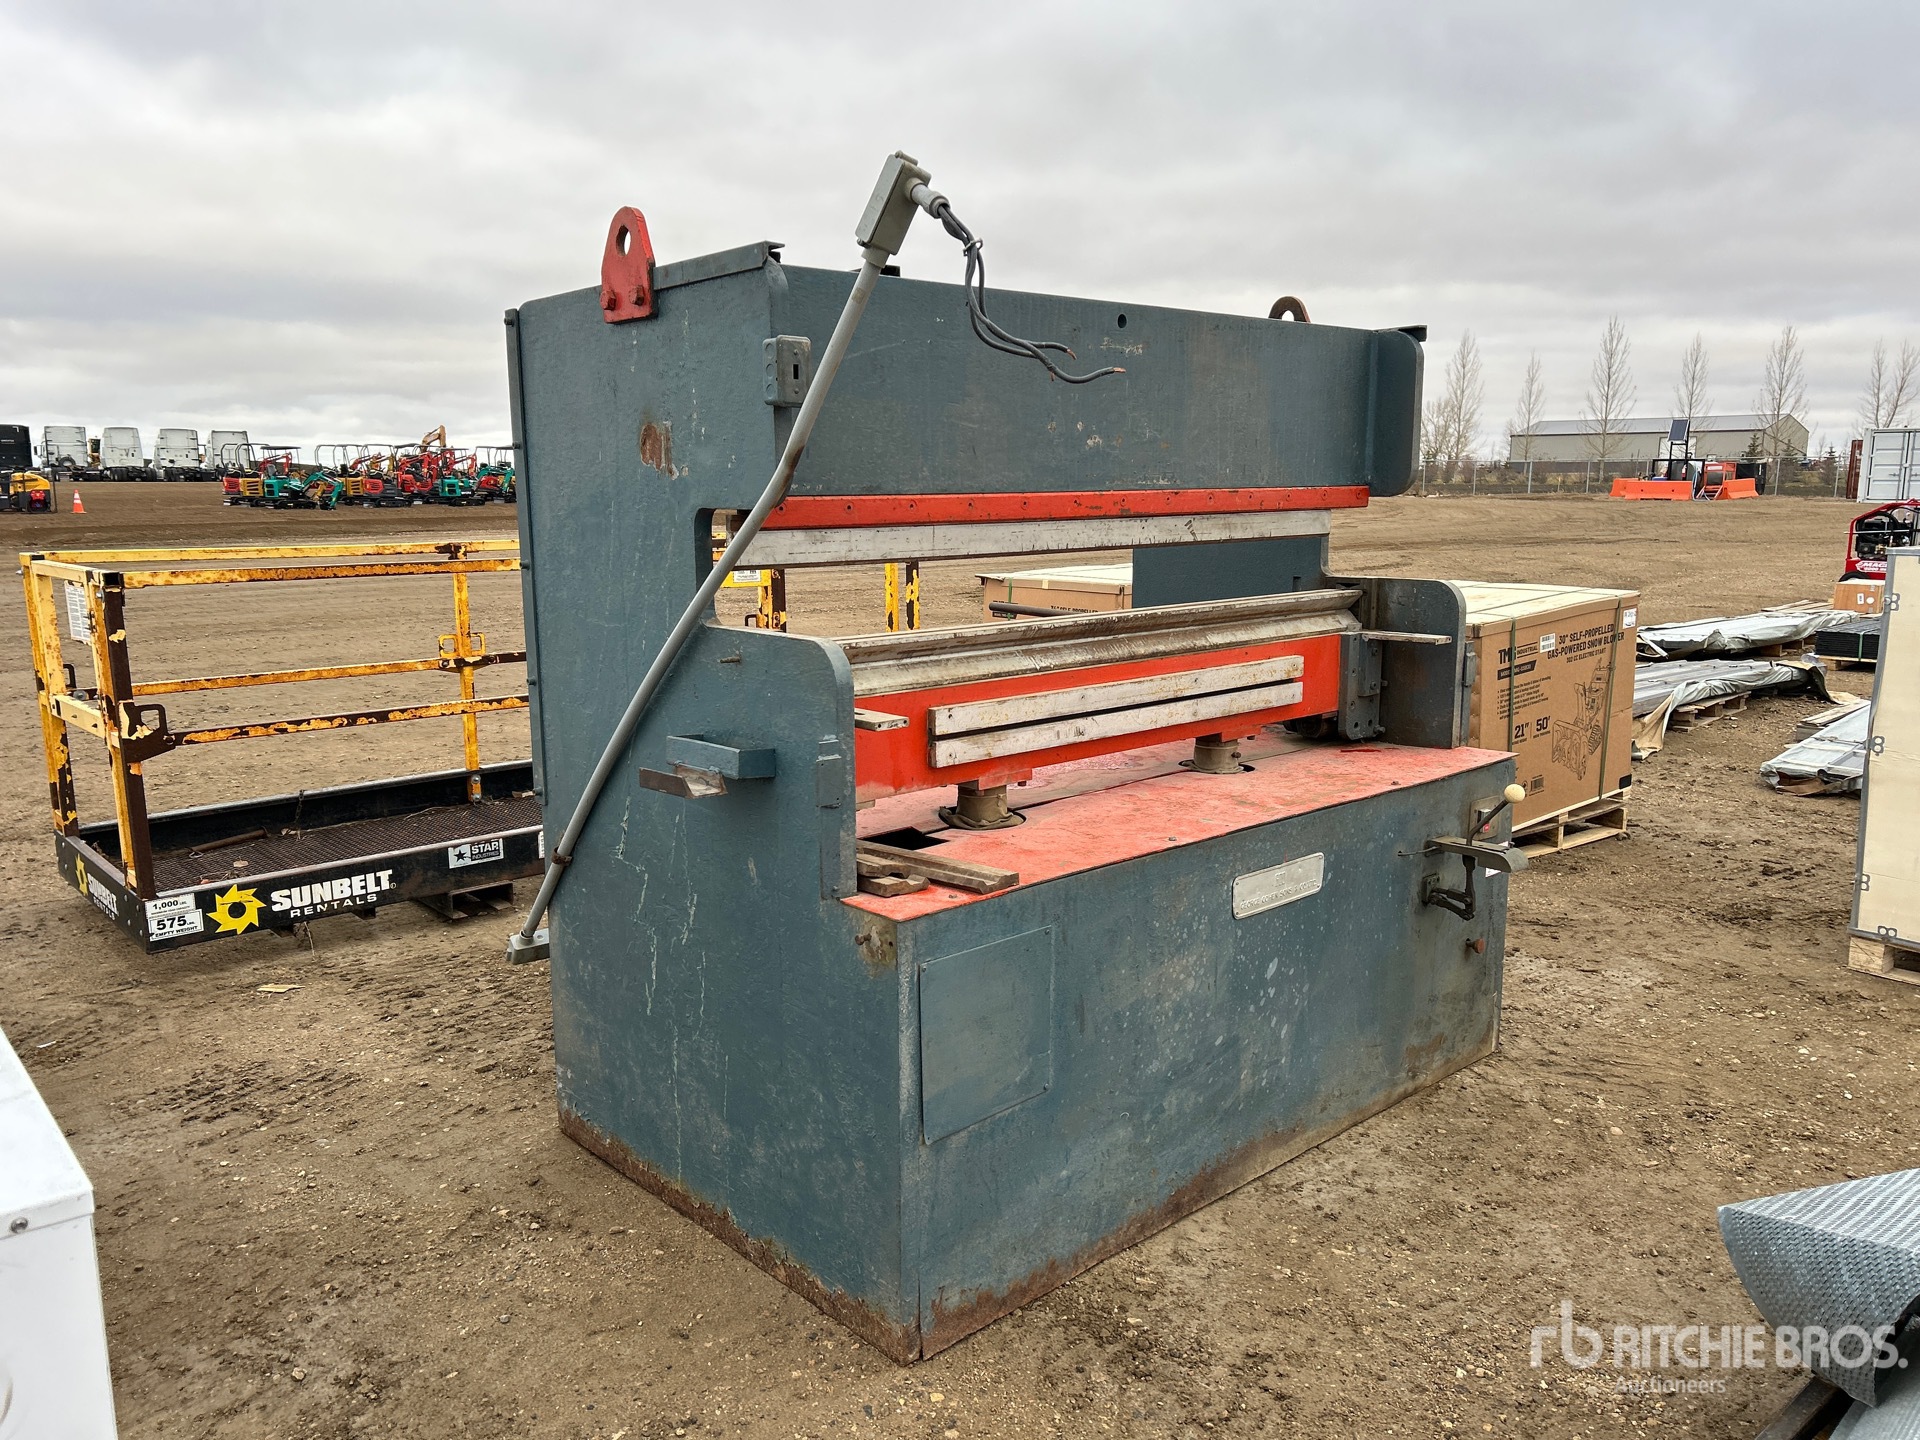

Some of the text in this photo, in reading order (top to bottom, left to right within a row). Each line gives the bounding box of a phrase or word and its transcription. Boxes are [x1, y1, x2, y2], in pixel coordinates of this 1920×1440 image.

[1569, 624, 1615, 642] SELF-PROPELLED
[1516, 645, 1538, 655] INDUSTRIAL
[1547, 642, 1587, 660] GAS-POWERED
[1587, 637, 1603, 650] SNOW
[1578, 650, 1595, 660] ELECTRIC
[471, 840, 500, 855] STAR
[471, 850, 500, 860] INDUSTRIES
[270, 869, 393, 912] SUNBELT
[152, 900, 179, 910] 1,000
[290, 893, 378, 918] RENTALS
[156, 915, 187, 931] 575
[155, 925, 198, 938] EMPTY WEIGHT
